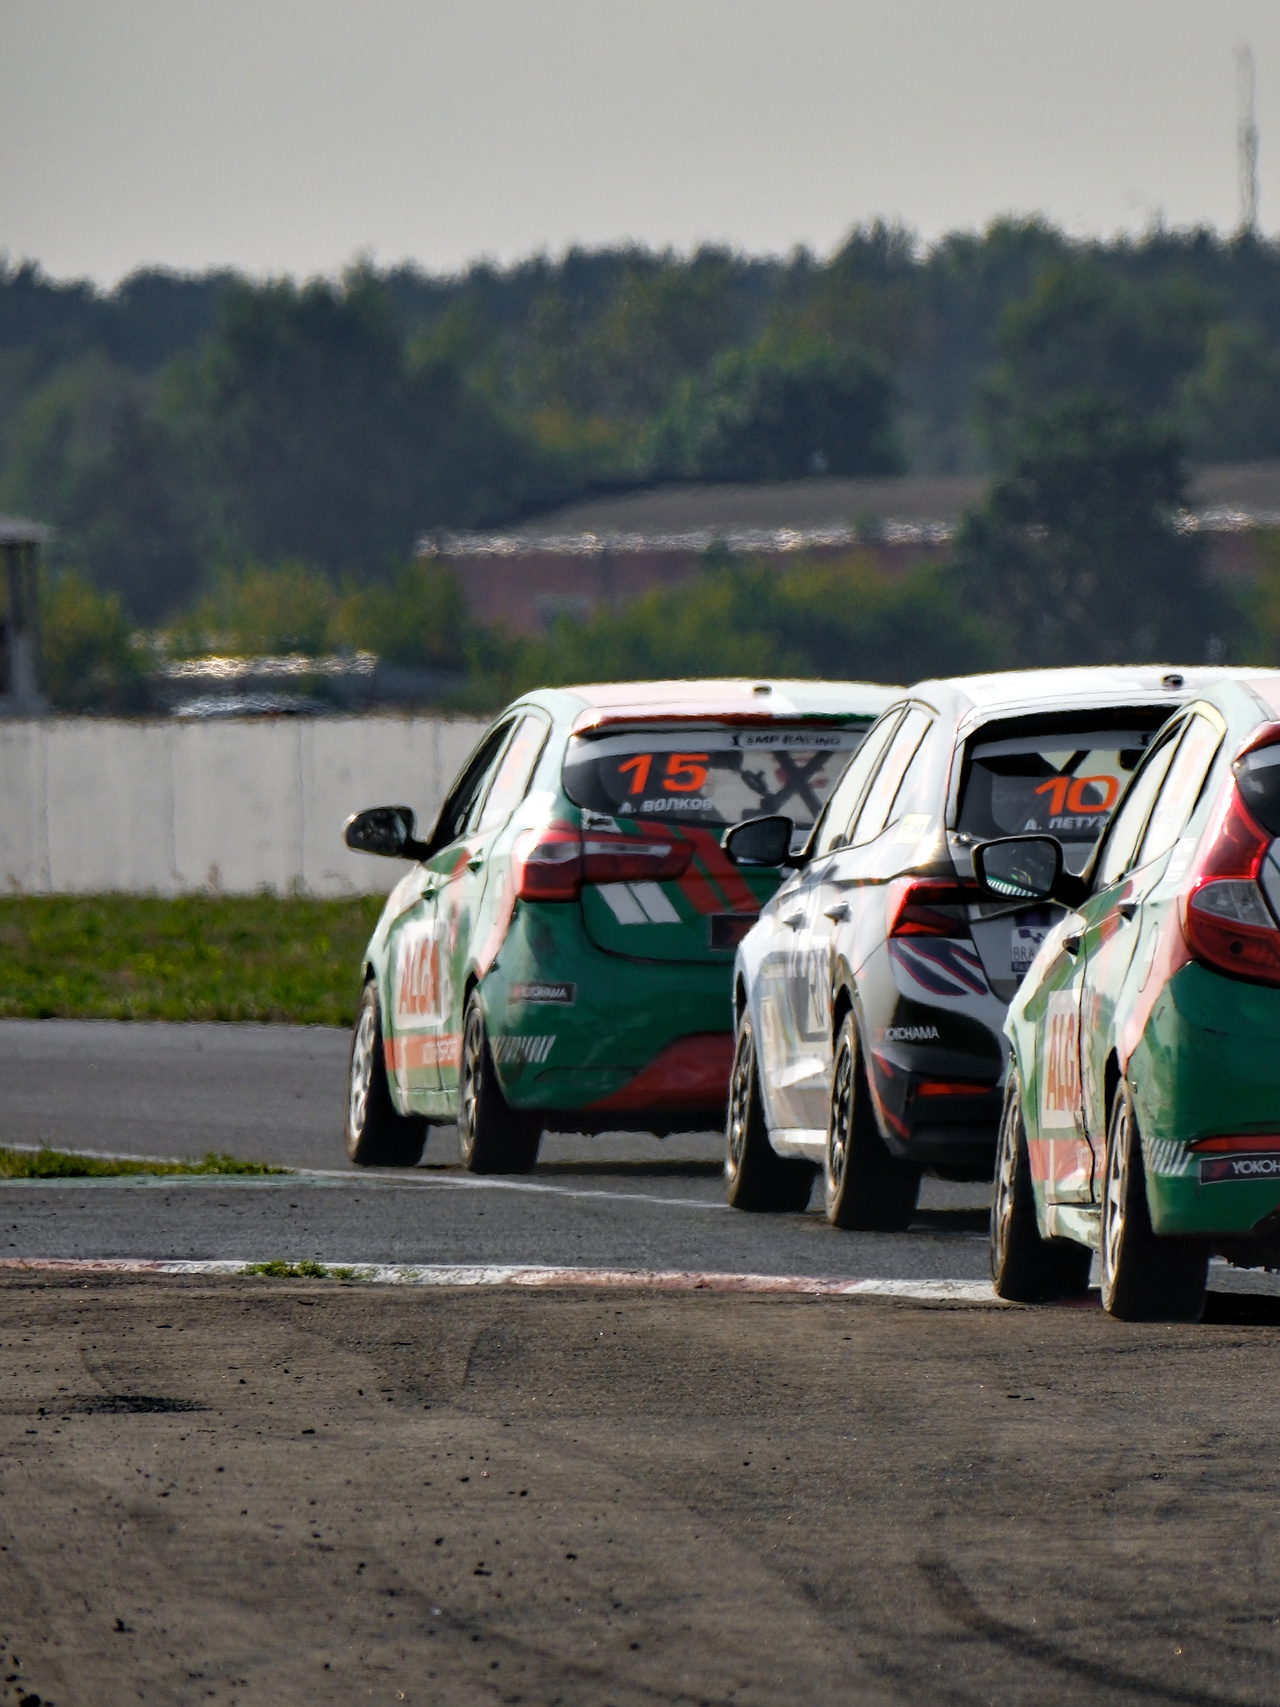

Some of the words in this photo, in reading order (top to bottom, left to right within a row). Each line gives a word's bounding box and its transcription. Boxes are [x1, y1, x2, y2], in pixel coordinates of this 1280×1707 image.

[618, 753, 709, 796] 15
[1034, 774, 1120, 816] 10
[1023, 818, 1043, 831] А.
[885, 1025, 940, 1041] YOKOHAMA
